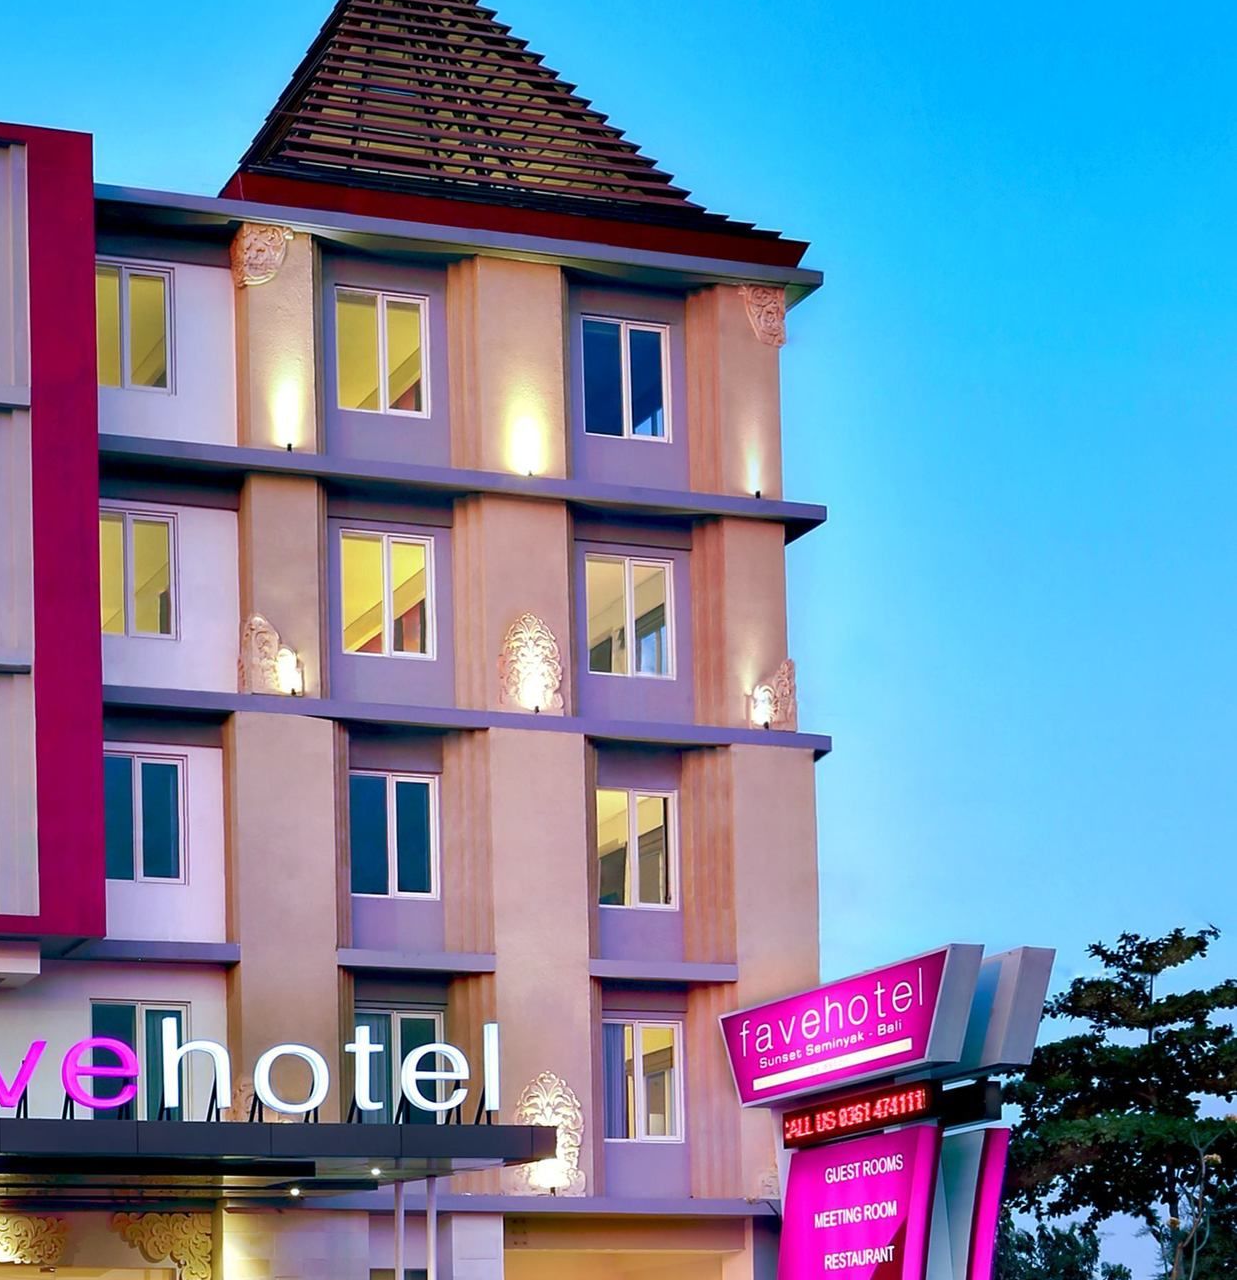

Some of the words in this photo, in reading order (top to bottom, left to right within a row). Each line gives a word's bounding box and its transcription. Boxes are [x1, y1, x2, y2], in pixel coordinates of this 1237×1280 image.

[739, 967, 923, 1057] favehotel
[759, 1048, 803, 1069] Sunset
[805, 1031, 865, 1057] Seminyak
[877, 1019, 903, 1037] Bali
[815, 1110, 837, 1133] US
[838, 1102, 871, 1127] 0361
[824, 1162, 861, 1184] GUEST
[862, 1154, 904, 1177] ROOMS
[813, 1205, 862, 1229] MEETING
[863, 1200, 898, 1221] ROOM
[824, 1245, 895, 1270] RESTAURANT
